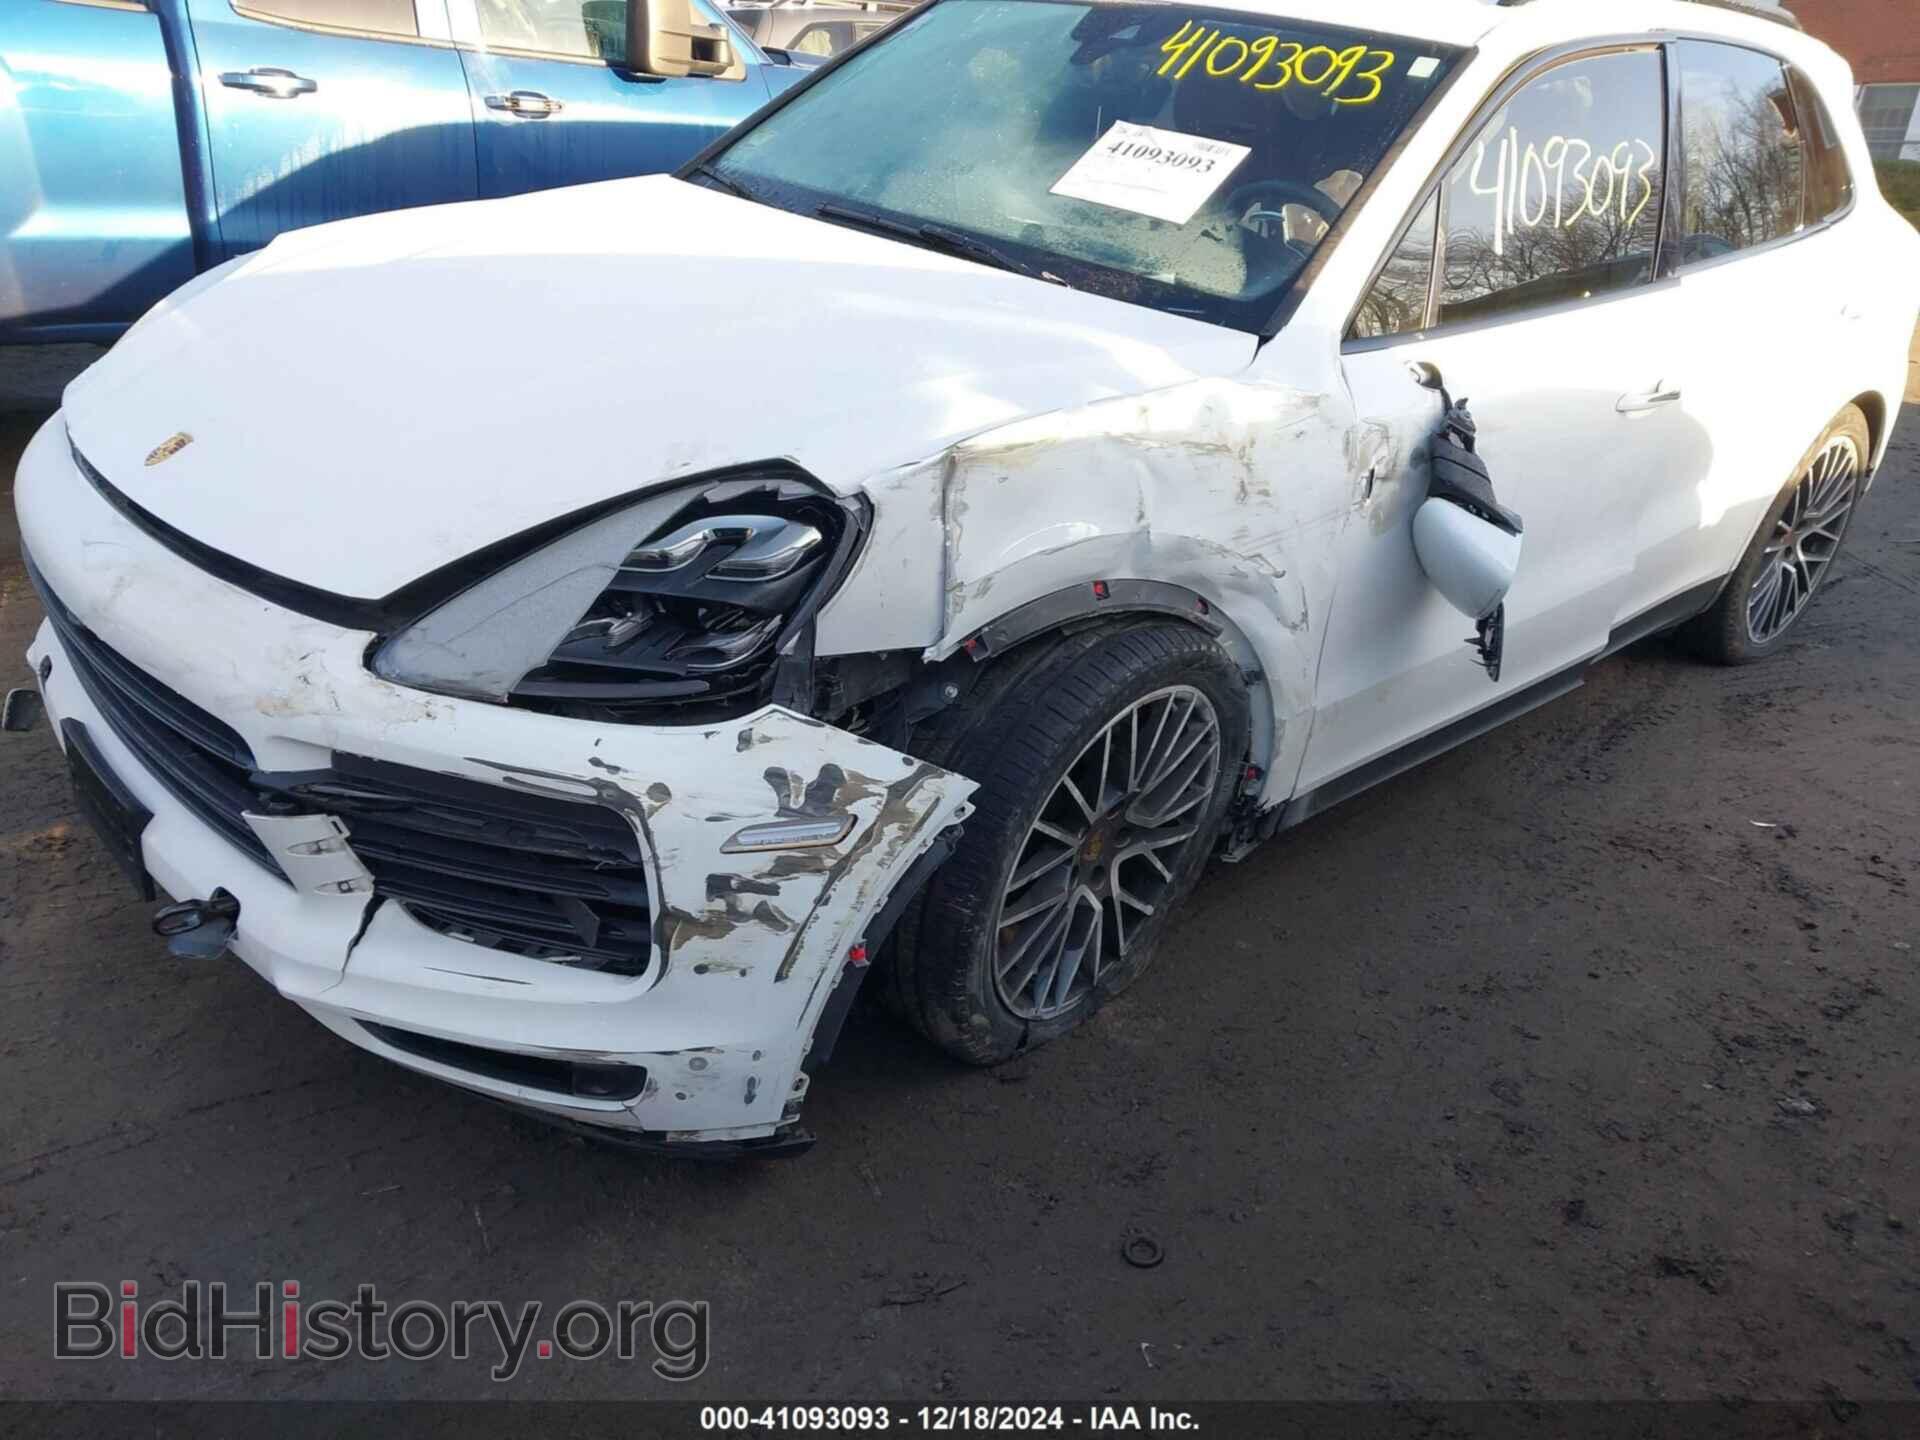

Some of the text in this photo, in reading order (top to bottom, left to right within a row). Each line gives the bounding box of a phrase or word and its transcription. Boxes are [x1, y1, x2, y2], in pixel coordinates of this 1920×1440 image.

[1156, 19, 1395, 104] 41093093
[1107, 139, 1216, 174] 41093093
[1470, 126, 1655, 256] 41093093
